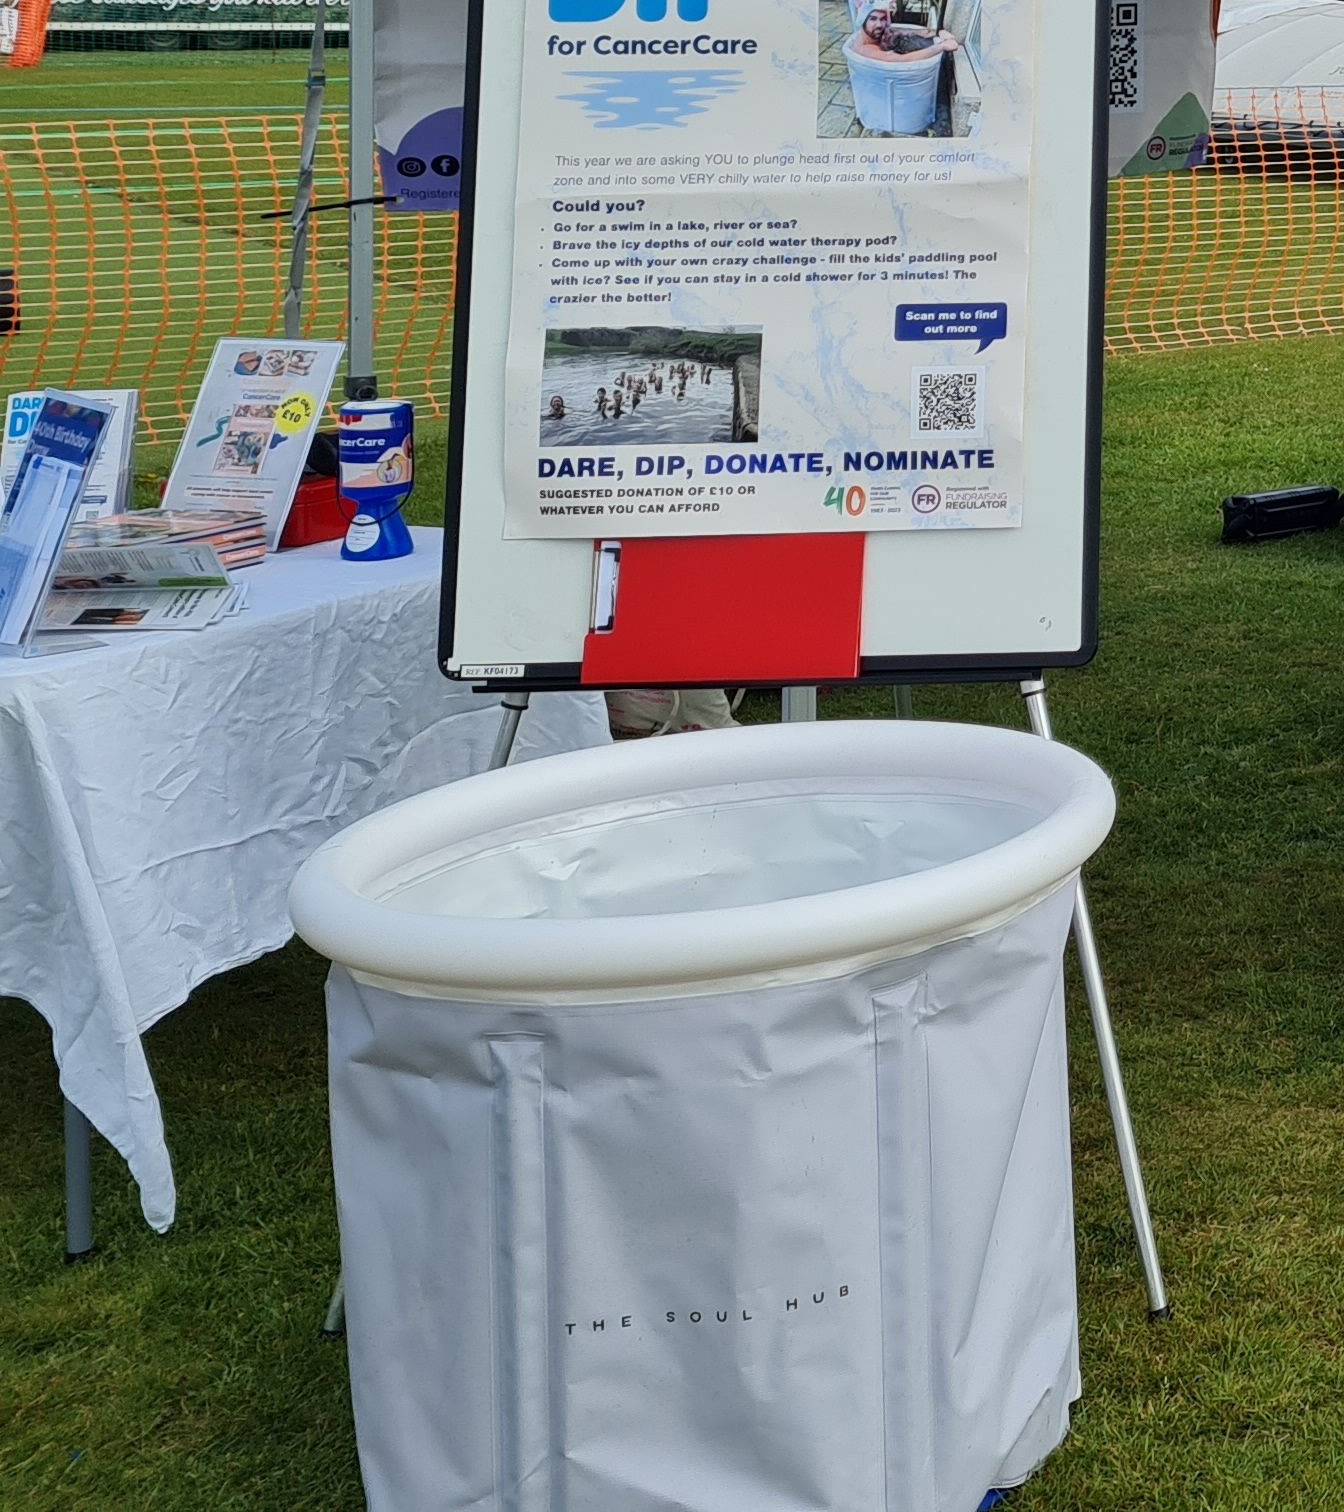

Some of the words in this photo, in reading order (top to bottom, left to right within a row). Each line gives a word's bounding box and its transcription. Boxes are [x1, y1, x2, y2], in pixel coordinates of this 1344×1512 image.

[548, 35, 586, 55] for
[593, 34, 758, 56] CancerCare
[552, 200, 600, 212] Could
[606, 199, 645, 214] you?
[554, 222, 572, 232] Go
[576, 222, 595, 232] for
[611, 221, 645, 232] swim
[649, 221, 661, 231] in
[677, 220, 710, 233] lake,
[713, 220, 745, 230] river
[748, 222, 763, 230] or
[766, 219, 798, 229] sea?
[552, 240, 592, 250] Brave
[596, 239, 617, 250] the
[621, 239, 641, 251] icy
[644, 238, 690, 250] depths
[693, 238, 707, 248] of
[736, 237, 765, 248] cold
[768, 237, 807, 247] water
[810, 236, 862, 248] therapy
[865, 235, 898, 247] pod?
[552, 257, 590, 268] Come
[594, 259, 610, 269] up
[614, 256, 643, 267] with
[646, 258, 677, 268] your
[712, 257, 749, 267] crazy
[752, 254, 817, 267] challenge
[829, 254, 845, 264] fill
[849, 253, 870, 263] the
[874, 253, 905, 263] kids'
[908, 252, 965, 264] paddling
[969, 252, 997, 263] pool
[550, 275, 578, 286] with
[582, 275, 611, 285] ice?
[614, 274, 640, 285] See
[644, 274, 654, 284] if
[656, 276, 681, 286] you
[713, 274, 741, 285] stay
[744, 273, 757, 283] in
[773, 272, 801, 282] cold
[805, 271, 854, 282] shower
[857, 271, 877, 281] for
[880, 271, 888, 281] 3
[892, 270, 949, 280] minutes!
[952, 269, 977, 280] The
[549, 293, 598, 304] crazier
[601, 293, 622, 303] the
[626, 292, 672, 302] better!
[905, 311, 936, 321] Scan
[959, 310, 972, 320] to
[974, 309, 998, 319] find
[924, 324, 944, 334] out
[282, 410, 302, 423] £10
[538, 456, 624, 482] DARE,
[635, 455, 693, 480] DIP,
[704, 452, 832, 479] DONATE,
[844, 449, 995, 472] NOMINATE
[539, 489, 613, 499] SUGGESTED
[617, 487, 684, 498] DONATION
[688, 486, 706, 496] OF
[709, 486, 734, 496] £10
[737, 486, 756, 495] OR
[946, 492, 1008, 500] FUNDRAISING
[823, 485, 866, 516] 40
[917, 494, 936, 506] FR
[946, 500, 1008, 510] REGULATOR
[539, 505, 604, 516] WHATEVER
[608, 504, 634, 514] YOU
[638, 504, 664, 514] CAN
[668, 503, 720, 513] AFFORD
[565, 1315, 632, 1335] THE
[666, 1310, 752, 1323] SOUL
[786, 1285, 849, 1311] HUB
